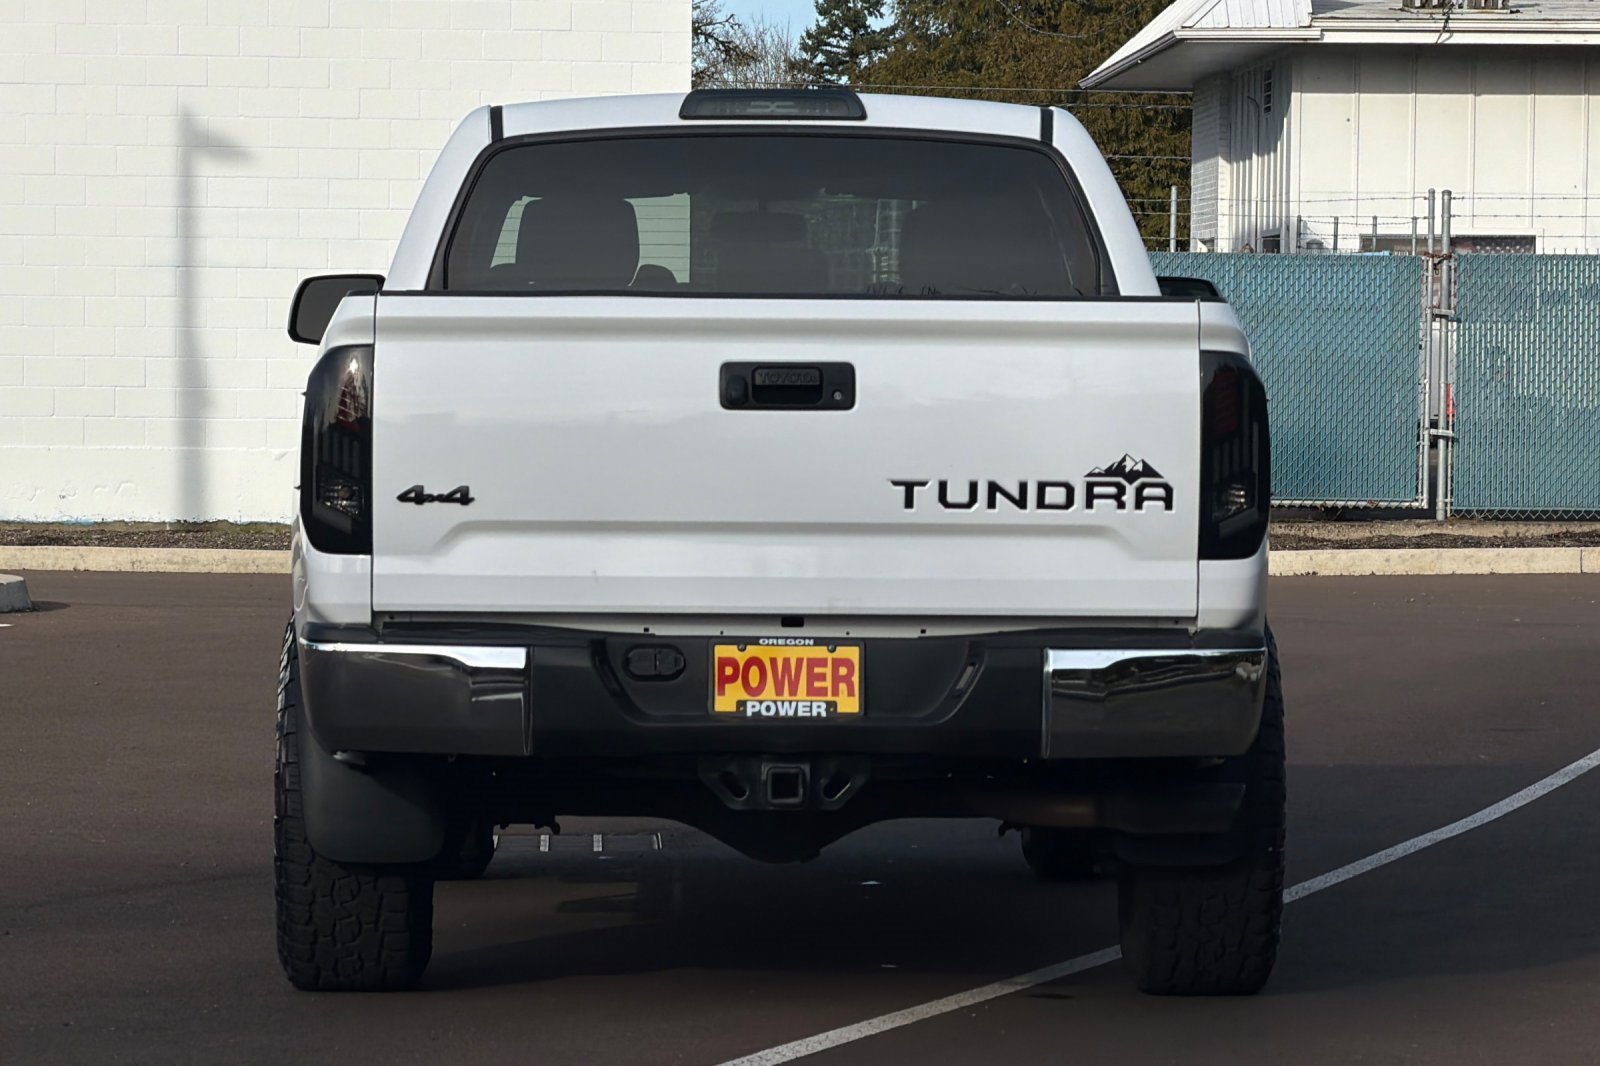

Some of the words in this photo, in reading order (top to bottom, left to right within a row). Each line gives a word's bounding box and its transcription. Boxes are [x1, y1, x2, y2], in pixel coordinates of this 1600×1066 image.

[889, 479, 1174, 511] TUNDRA
[717, 656, 856, 697] POWER
[746, 701, 827, 716] POWER
